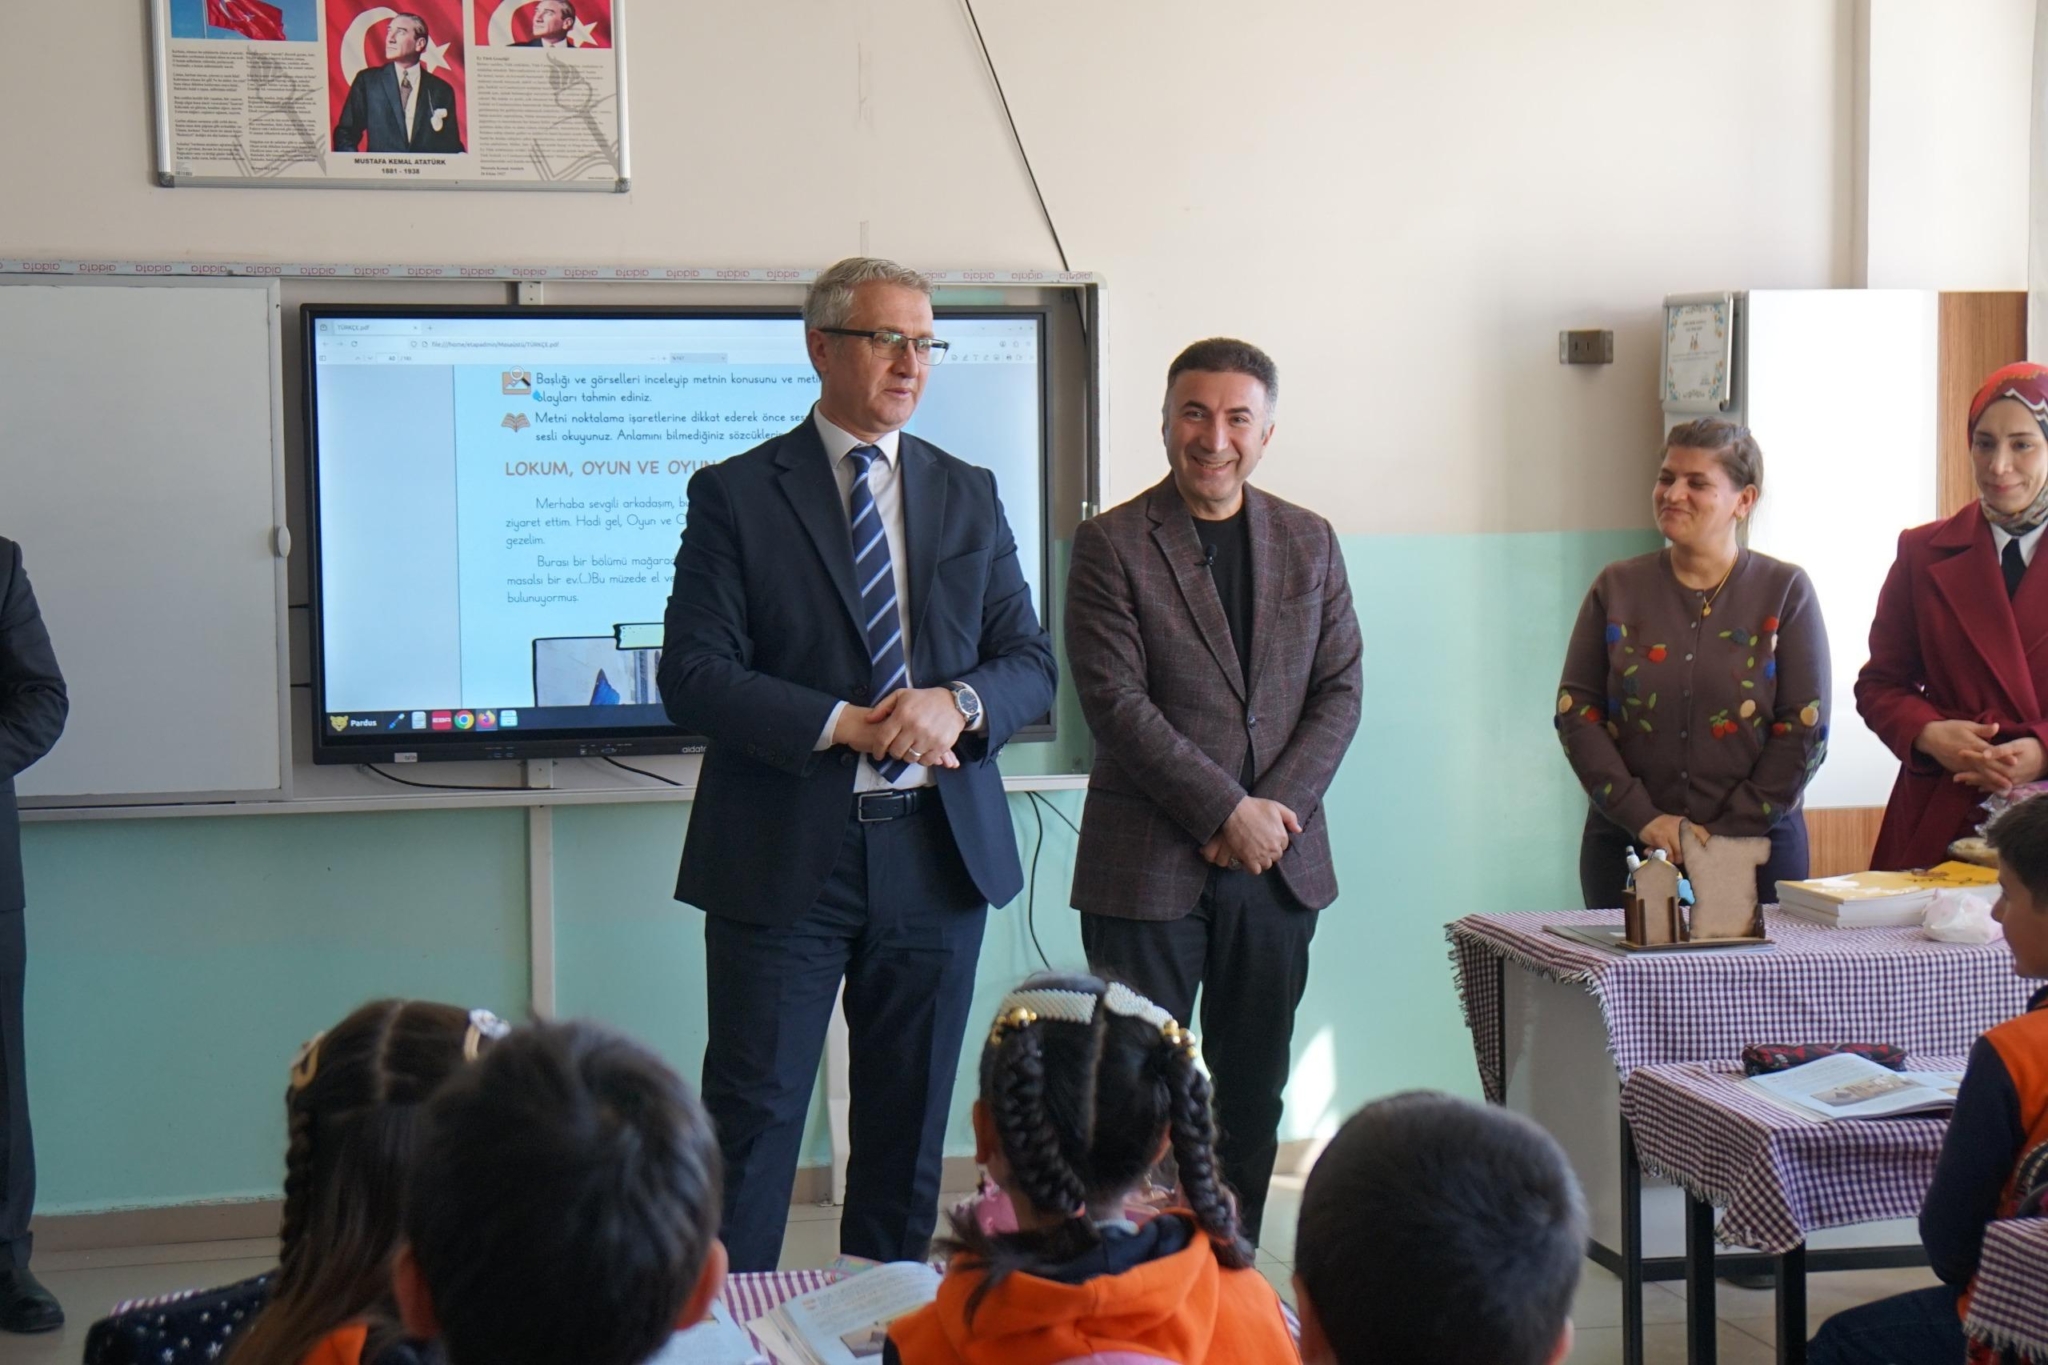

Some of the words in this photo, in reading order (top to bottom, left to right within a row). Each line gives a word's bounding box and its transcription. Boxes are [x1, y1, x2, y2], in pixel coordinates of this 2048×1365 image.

[414, 158, 446, 166] ATATÜRK
[536, 372, 570, 389] Başlığı
[575, 377, 587, 385] ve
[591, 372, 640, 389] görselleri
[644, 372, 689, 389] inceleyip
[693, 373, 727, 384] metnin
[731, 372, 778, 384] konusunu
[781, 376, 793, 384] ve
[581, 390, 616, 403] tahmin
[620, 390, 652, 402] ediniz.
[535, 411, 568, 424] Metni
[571, 411, 625, 423] noktalama
[629, 411, 687, 424] işaretlerine
[690, 410, 720, 423] dikkat
[724, 410, 758, 423] ederek
[762, 412, 786, 423] önce
[535, 429, 558, 442] sesli
[561, 429, 613, 446] okuyunuz.
[616, 428, 662, 441] Anlamını
[666, 428, 725, 445] bilmediğiniz
[505, 461, 574, 478] LOKUM,
[581, 460, 631, 476] OYUN
[637, 460, 660, 475] VE
[535, 497, 585, 509] Merhaba
[589, 497, 619, 513] sevgili
[622, 496, 675, 510] arkadaşım,
[505, 517, 541, 532] ziyaret
[576, 514, 601, 527] Hadi
[626, 513, 657, 531] Oyun
[660, 518, 672, 526] ve
[505, 534, 545, 550] gezelim.
[537, 555, 569, 568] Burası
[573, 555, 588, 567] bir
[591, 555, 628, 567] bölümü
[507, 573, 544, 586] masalsı
[547, 573, 561, 585] bir
[609, 571, 647, 584] müzede
[650, 571, 660, 583] el
[507, 591, 579, 608] bulunuyormuş.
[350, 719, 378, 728] Pardus
